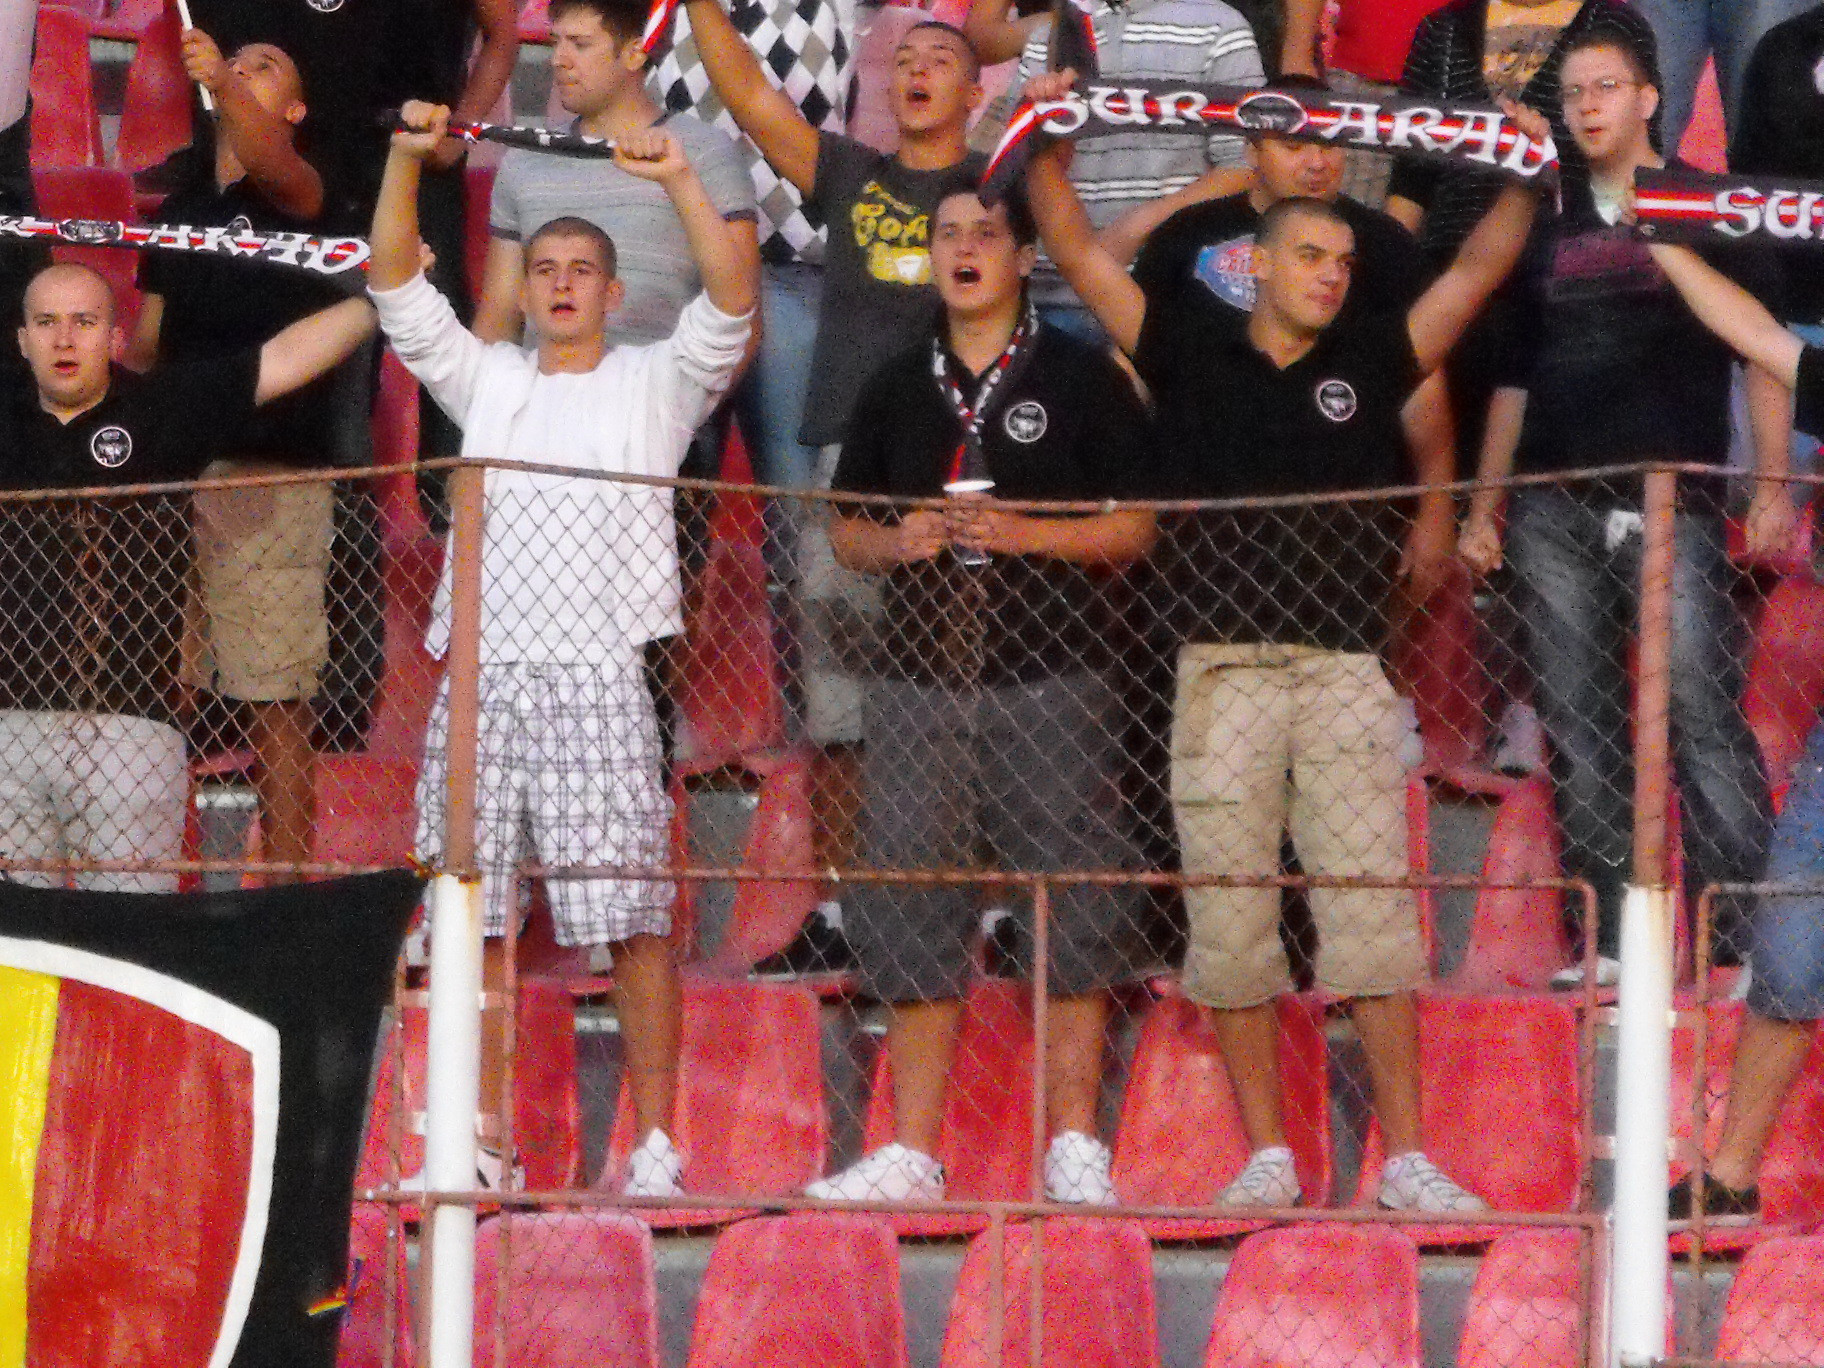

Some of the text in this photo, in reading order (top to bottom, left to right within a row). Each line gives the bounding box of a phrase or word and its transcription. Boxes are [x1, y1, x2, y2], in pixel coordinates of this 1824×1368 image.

[1041, 87, 1558, 176] SUR ARAD
[1712, 186, 1824, 240] SU
